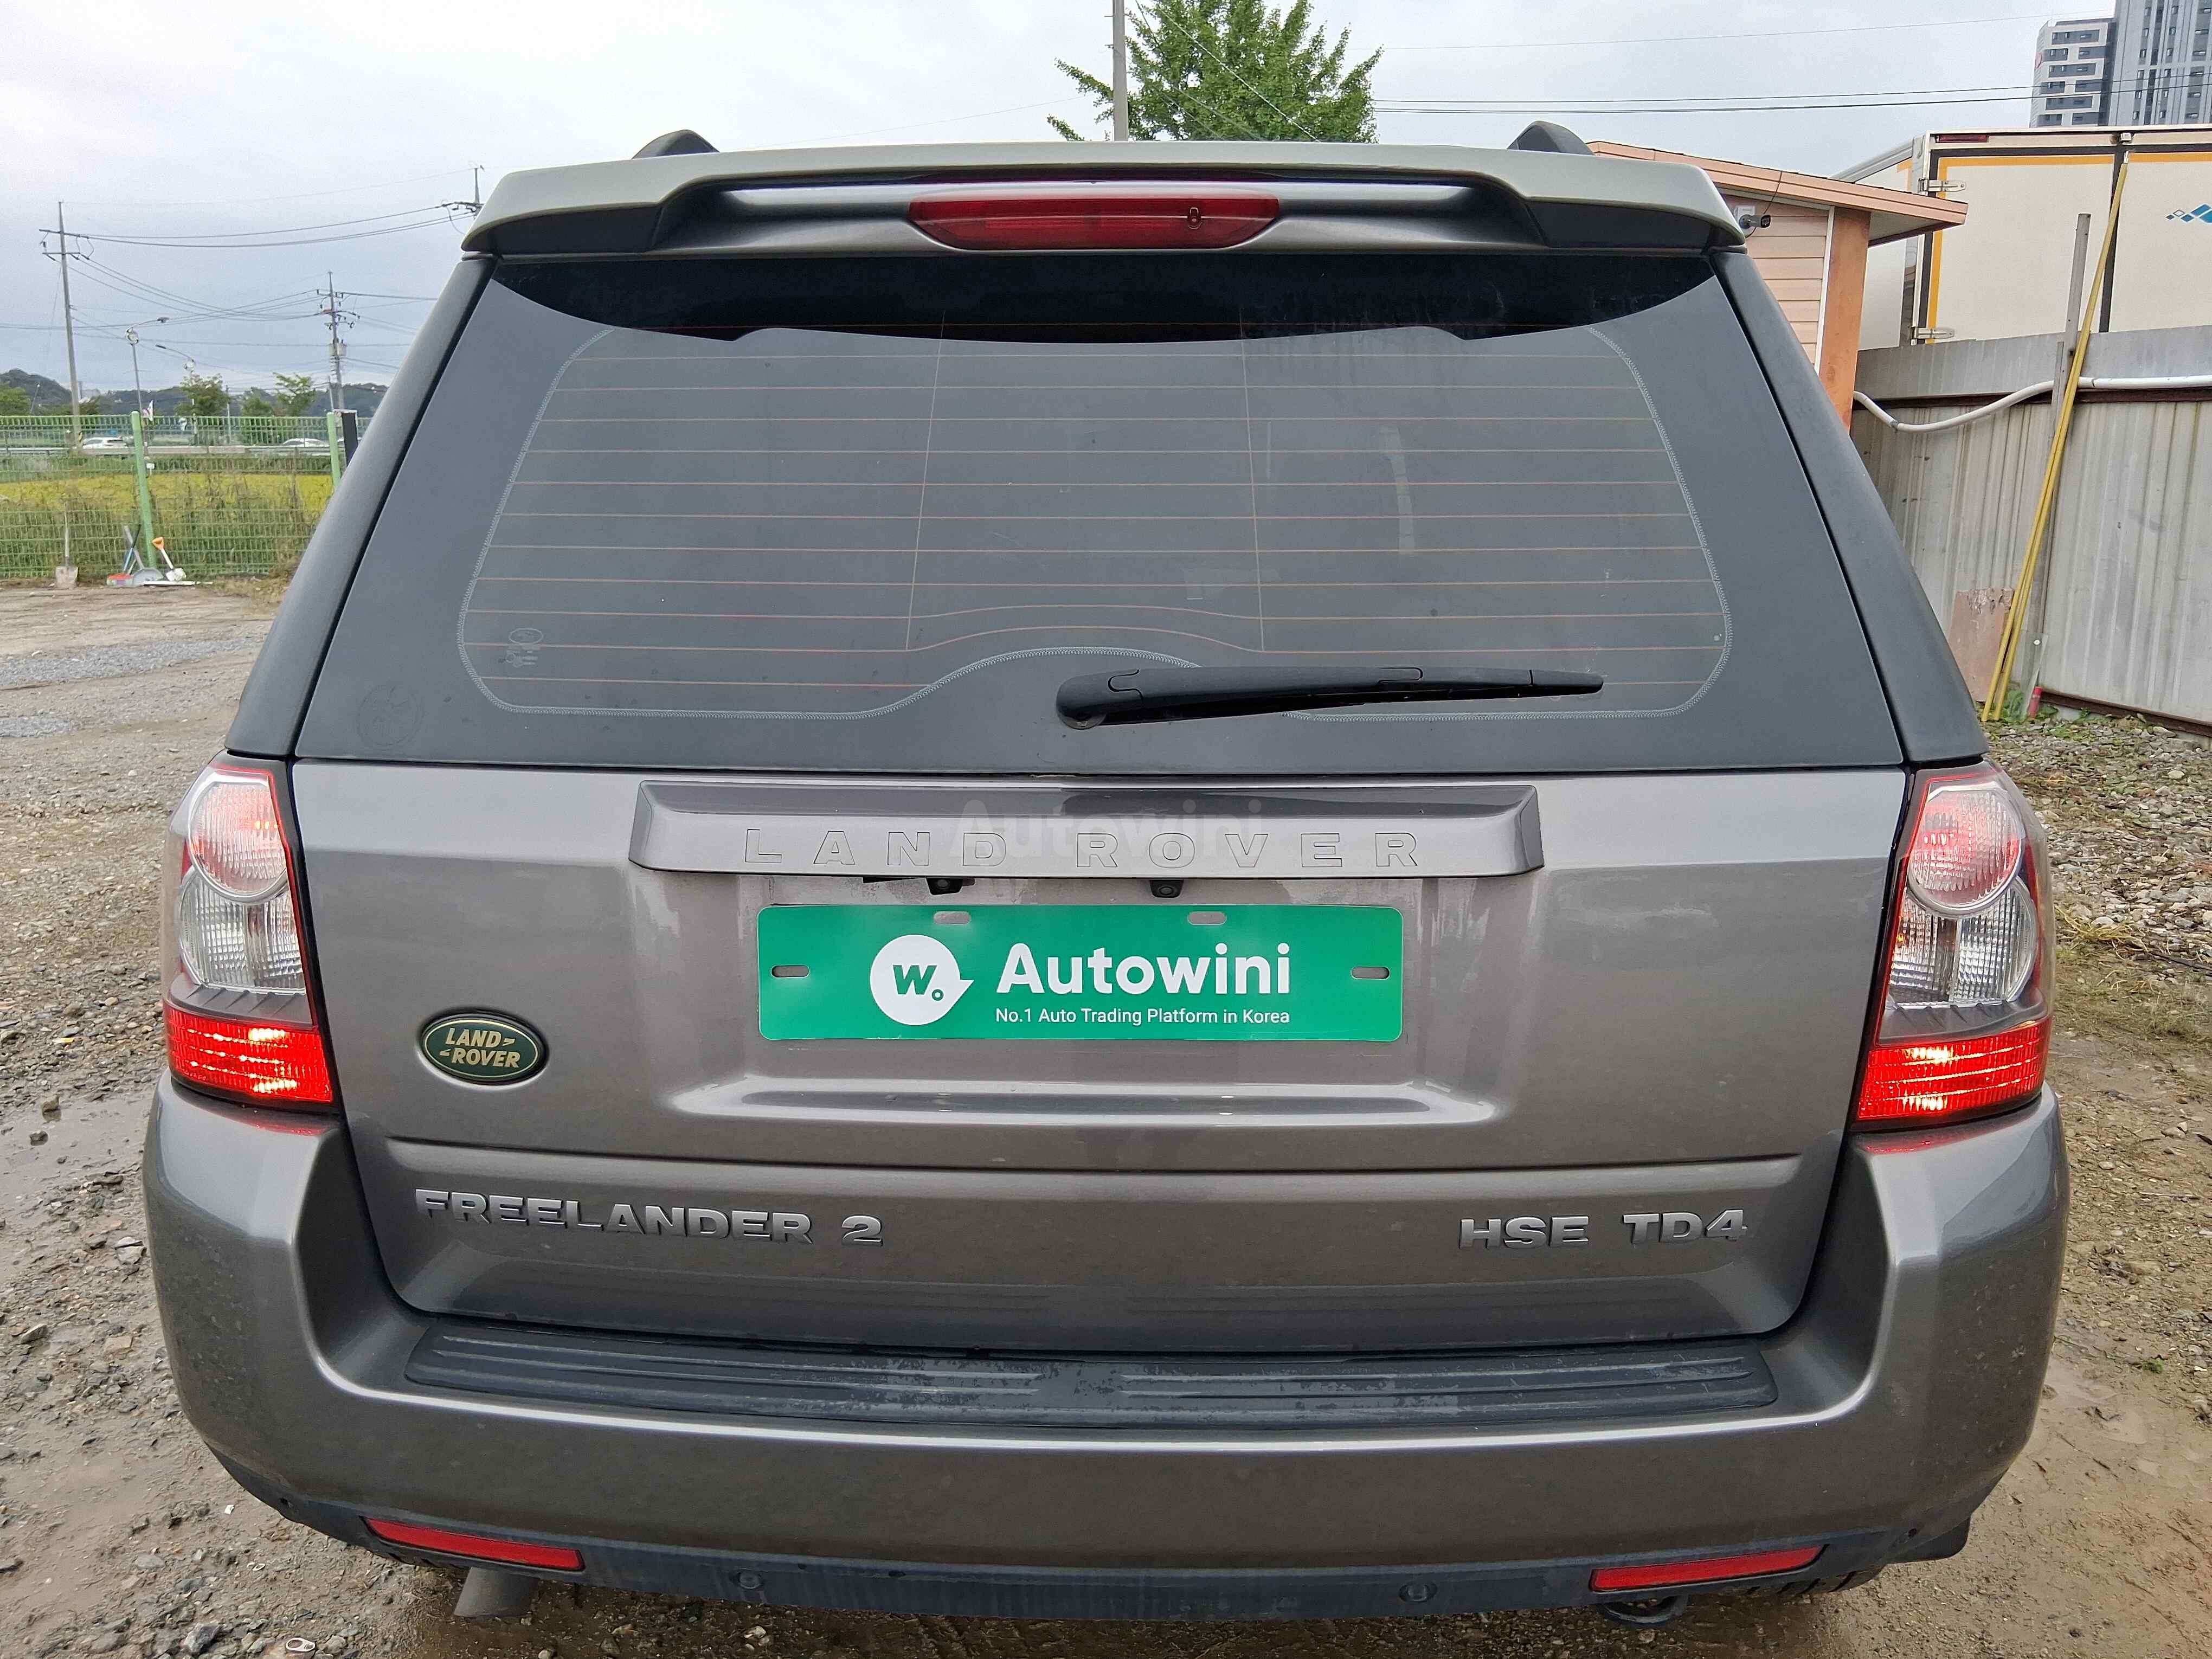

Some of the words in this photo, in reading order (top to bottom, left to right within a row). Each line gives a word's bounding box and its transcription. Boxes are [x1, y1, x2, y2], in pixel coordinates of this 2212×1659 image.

[745, 829, 1007, 867] LAND
[1077, 832, 1417, 869] ROVER
[996, 943, 1290, 994] Autowini
[996, 1008, 1031, 1023] No.1
[1038, 1008, 1076, 1023] Auto
[1081, 1008, 1142, 1026] Trading
[1147, 1008, 1218, 1024] Platform
[1224, 1009, 1237, 1024] in
[1243, 1009, 1290, 1024] Korea
[445, 1027, 501, 1048] LAND
[451, 1047, 520, 1068] ROVER
[415, 1188, 813, 1245] FREELANDER
[841, 1214, 883, 1247] 2
[1459, 1216, 1589, 1249] HSE
[1622, 1209, 1748, 1244] TD4
